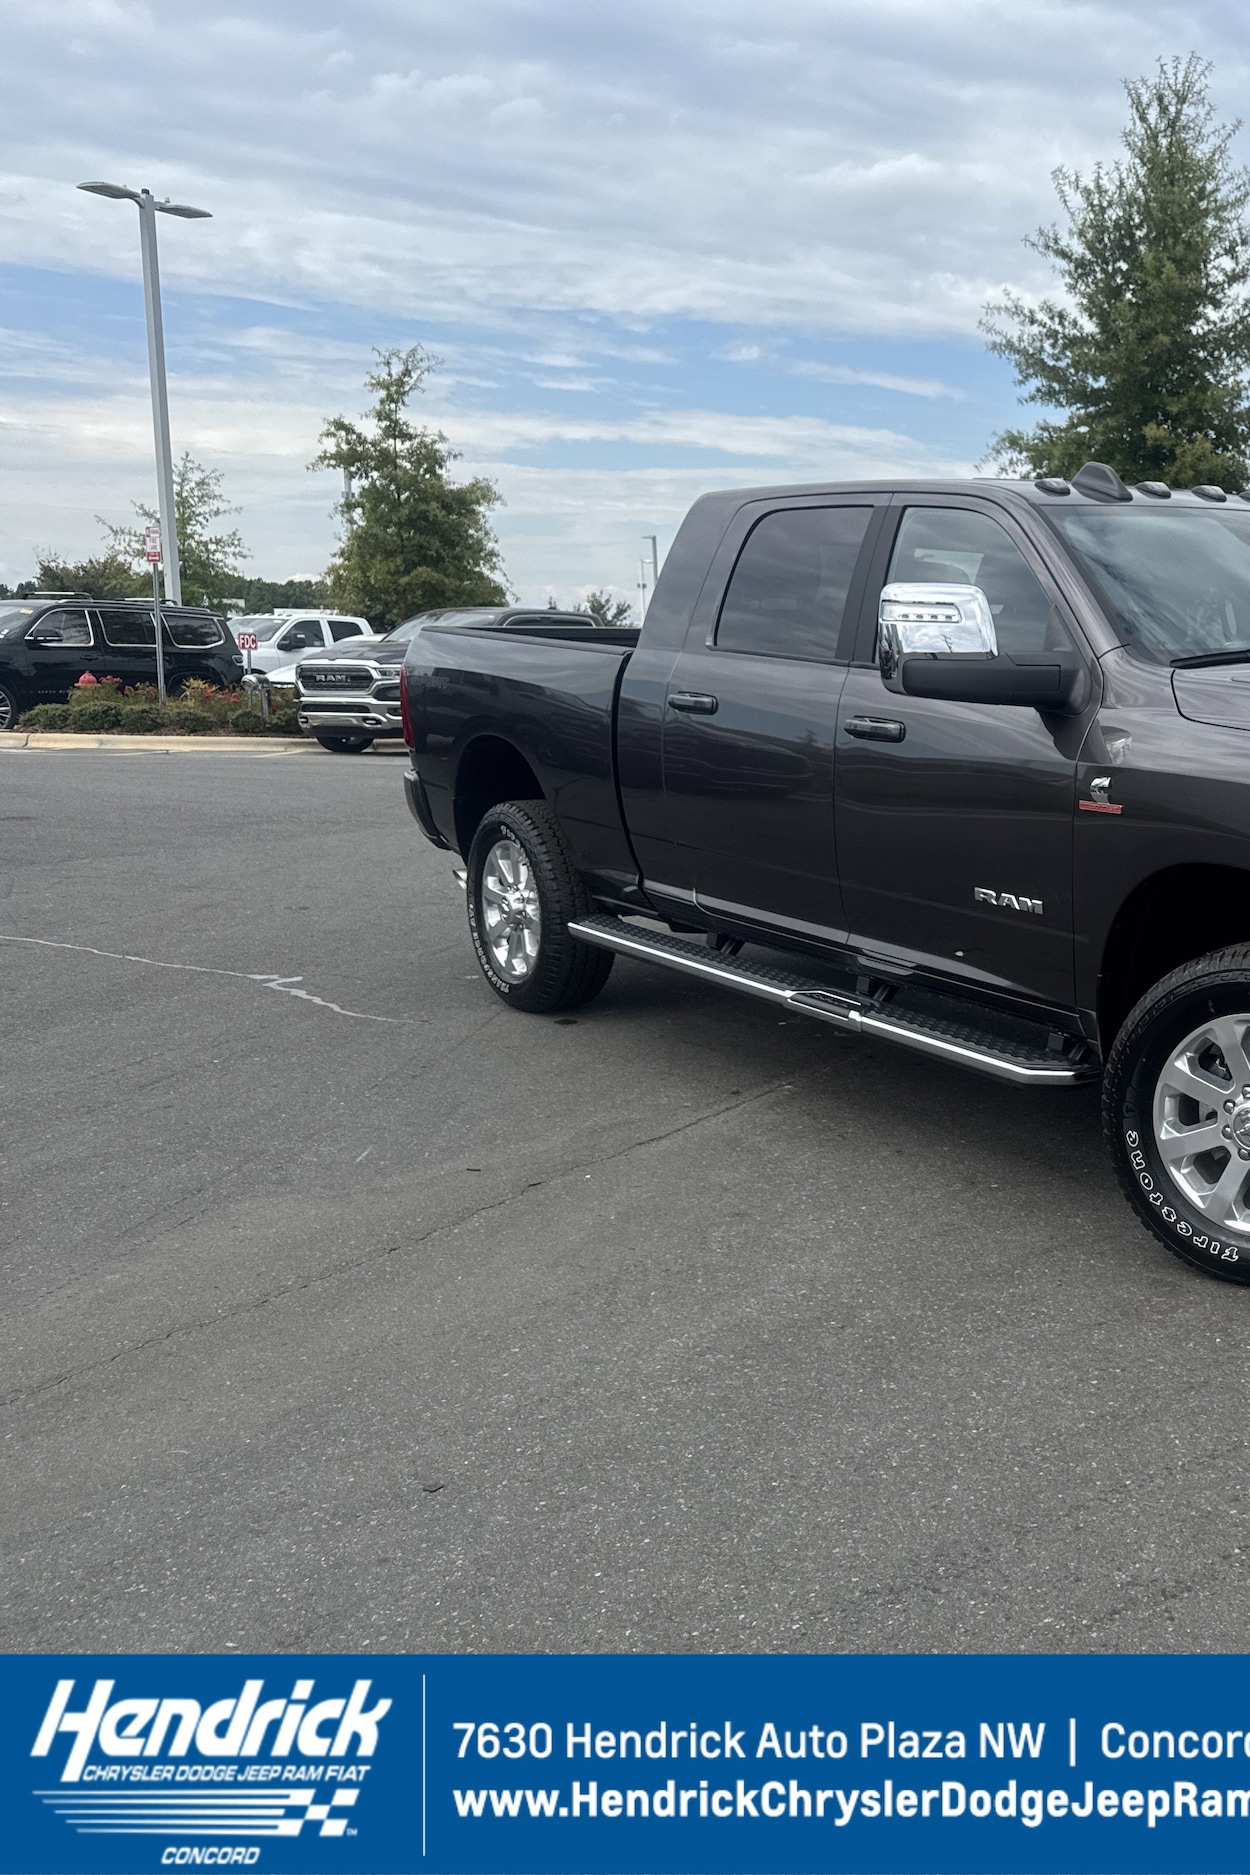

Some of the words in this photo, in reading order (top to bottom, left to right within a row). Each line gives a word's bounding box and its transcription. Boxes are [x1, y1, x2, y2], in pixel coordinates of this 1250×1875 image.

[239, 634, 256, 649] FDC
[315, 673, 347, 682] RAM
[974, 886, 1044, 915] RAM
